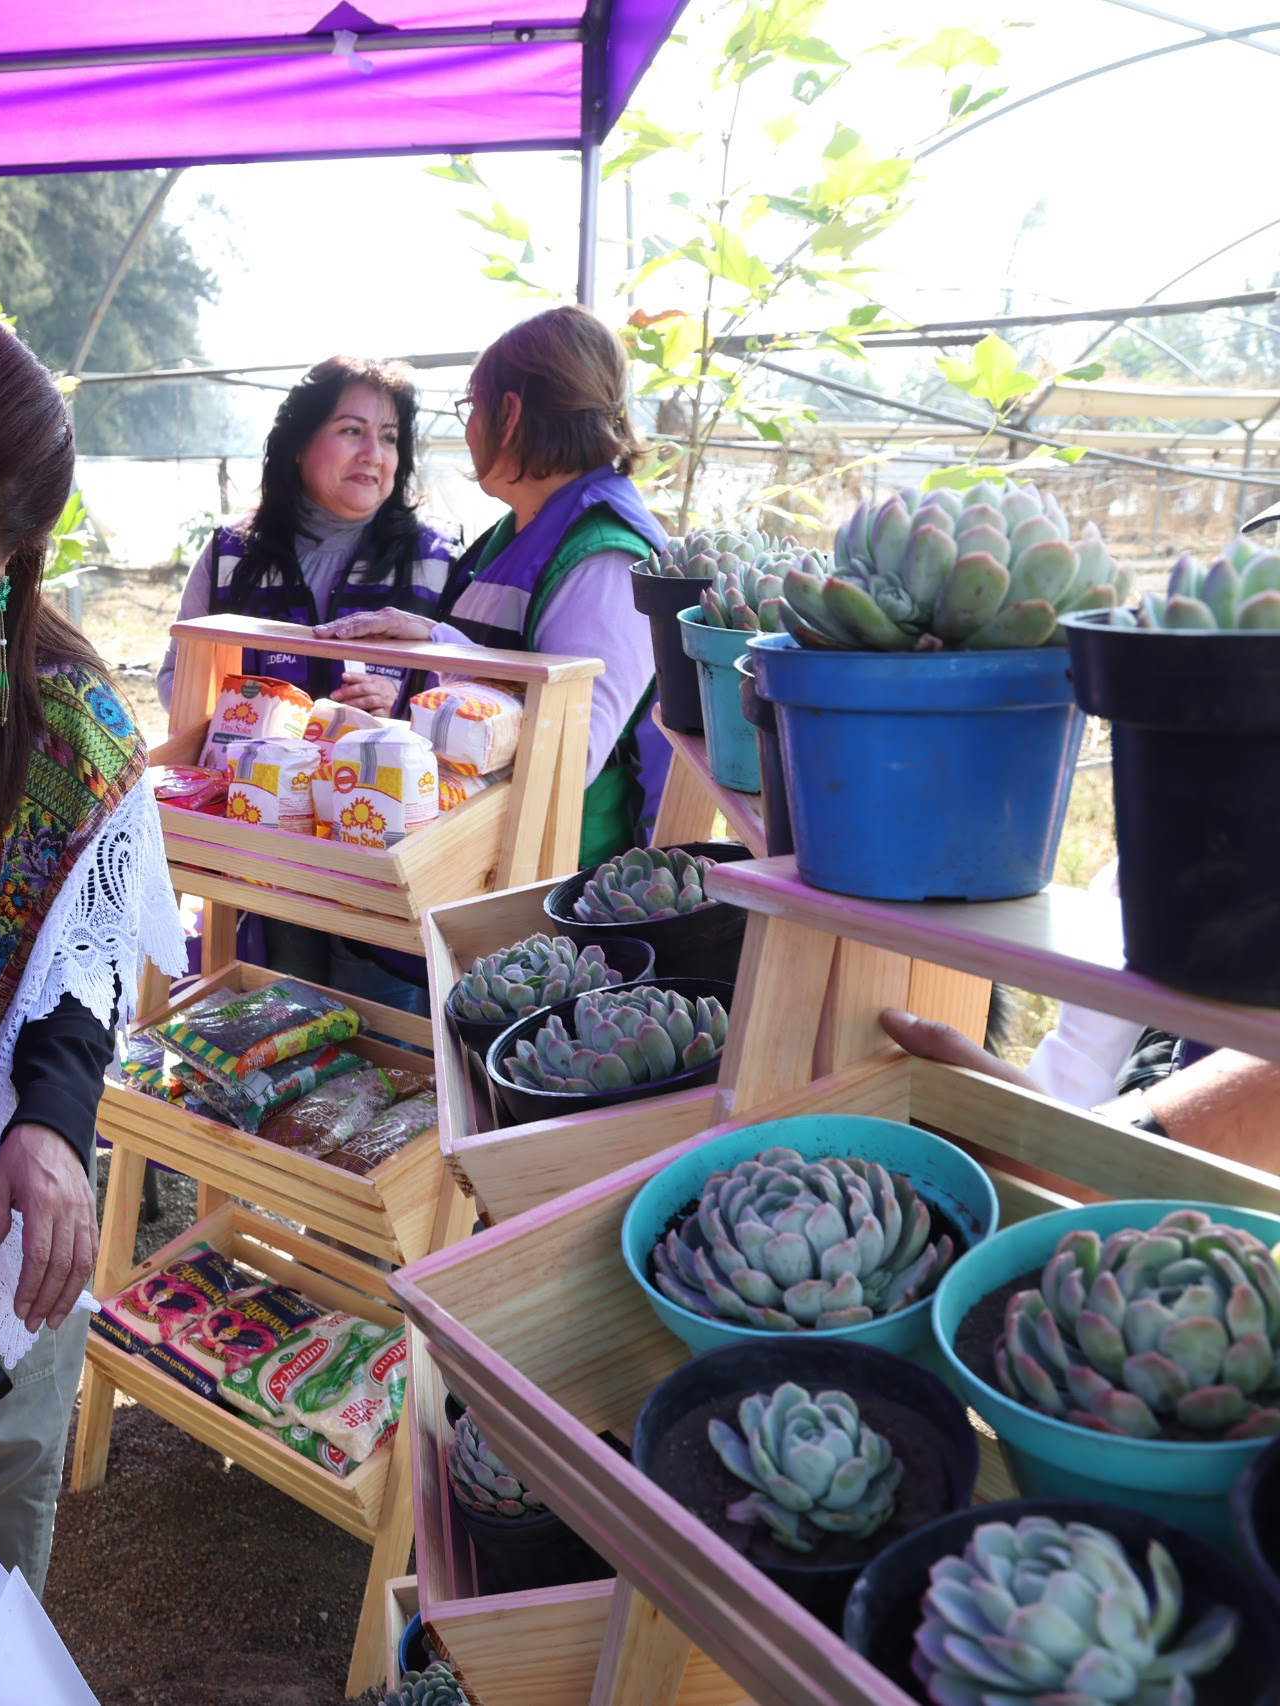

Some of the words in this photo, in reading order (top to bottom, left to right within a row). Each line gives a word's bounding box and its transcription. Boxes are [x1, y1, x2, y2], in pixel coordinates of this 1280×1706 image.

[267, 653, 297, 665] EDEMA
[234, 725, 252, 735] Soles
[340, 830, 360, 845] Tres
[360, 833, 385, 850] Soles
[163, 1261, 227, 1305] CARNAVAL
[226, 1297, 294, 1341] CARNAVAL
[150, 1346, 171, 1362] AZÚCAR
[169, 1358, 196, 1380] ESTÁNDAR
[270, 1340, 328, 1394] Schettino
[374, 1340, 407, 1374] ettino
[338, 1398, 372, 1419] EXTRA
[345, 1398, 384, 1429] SUPER
